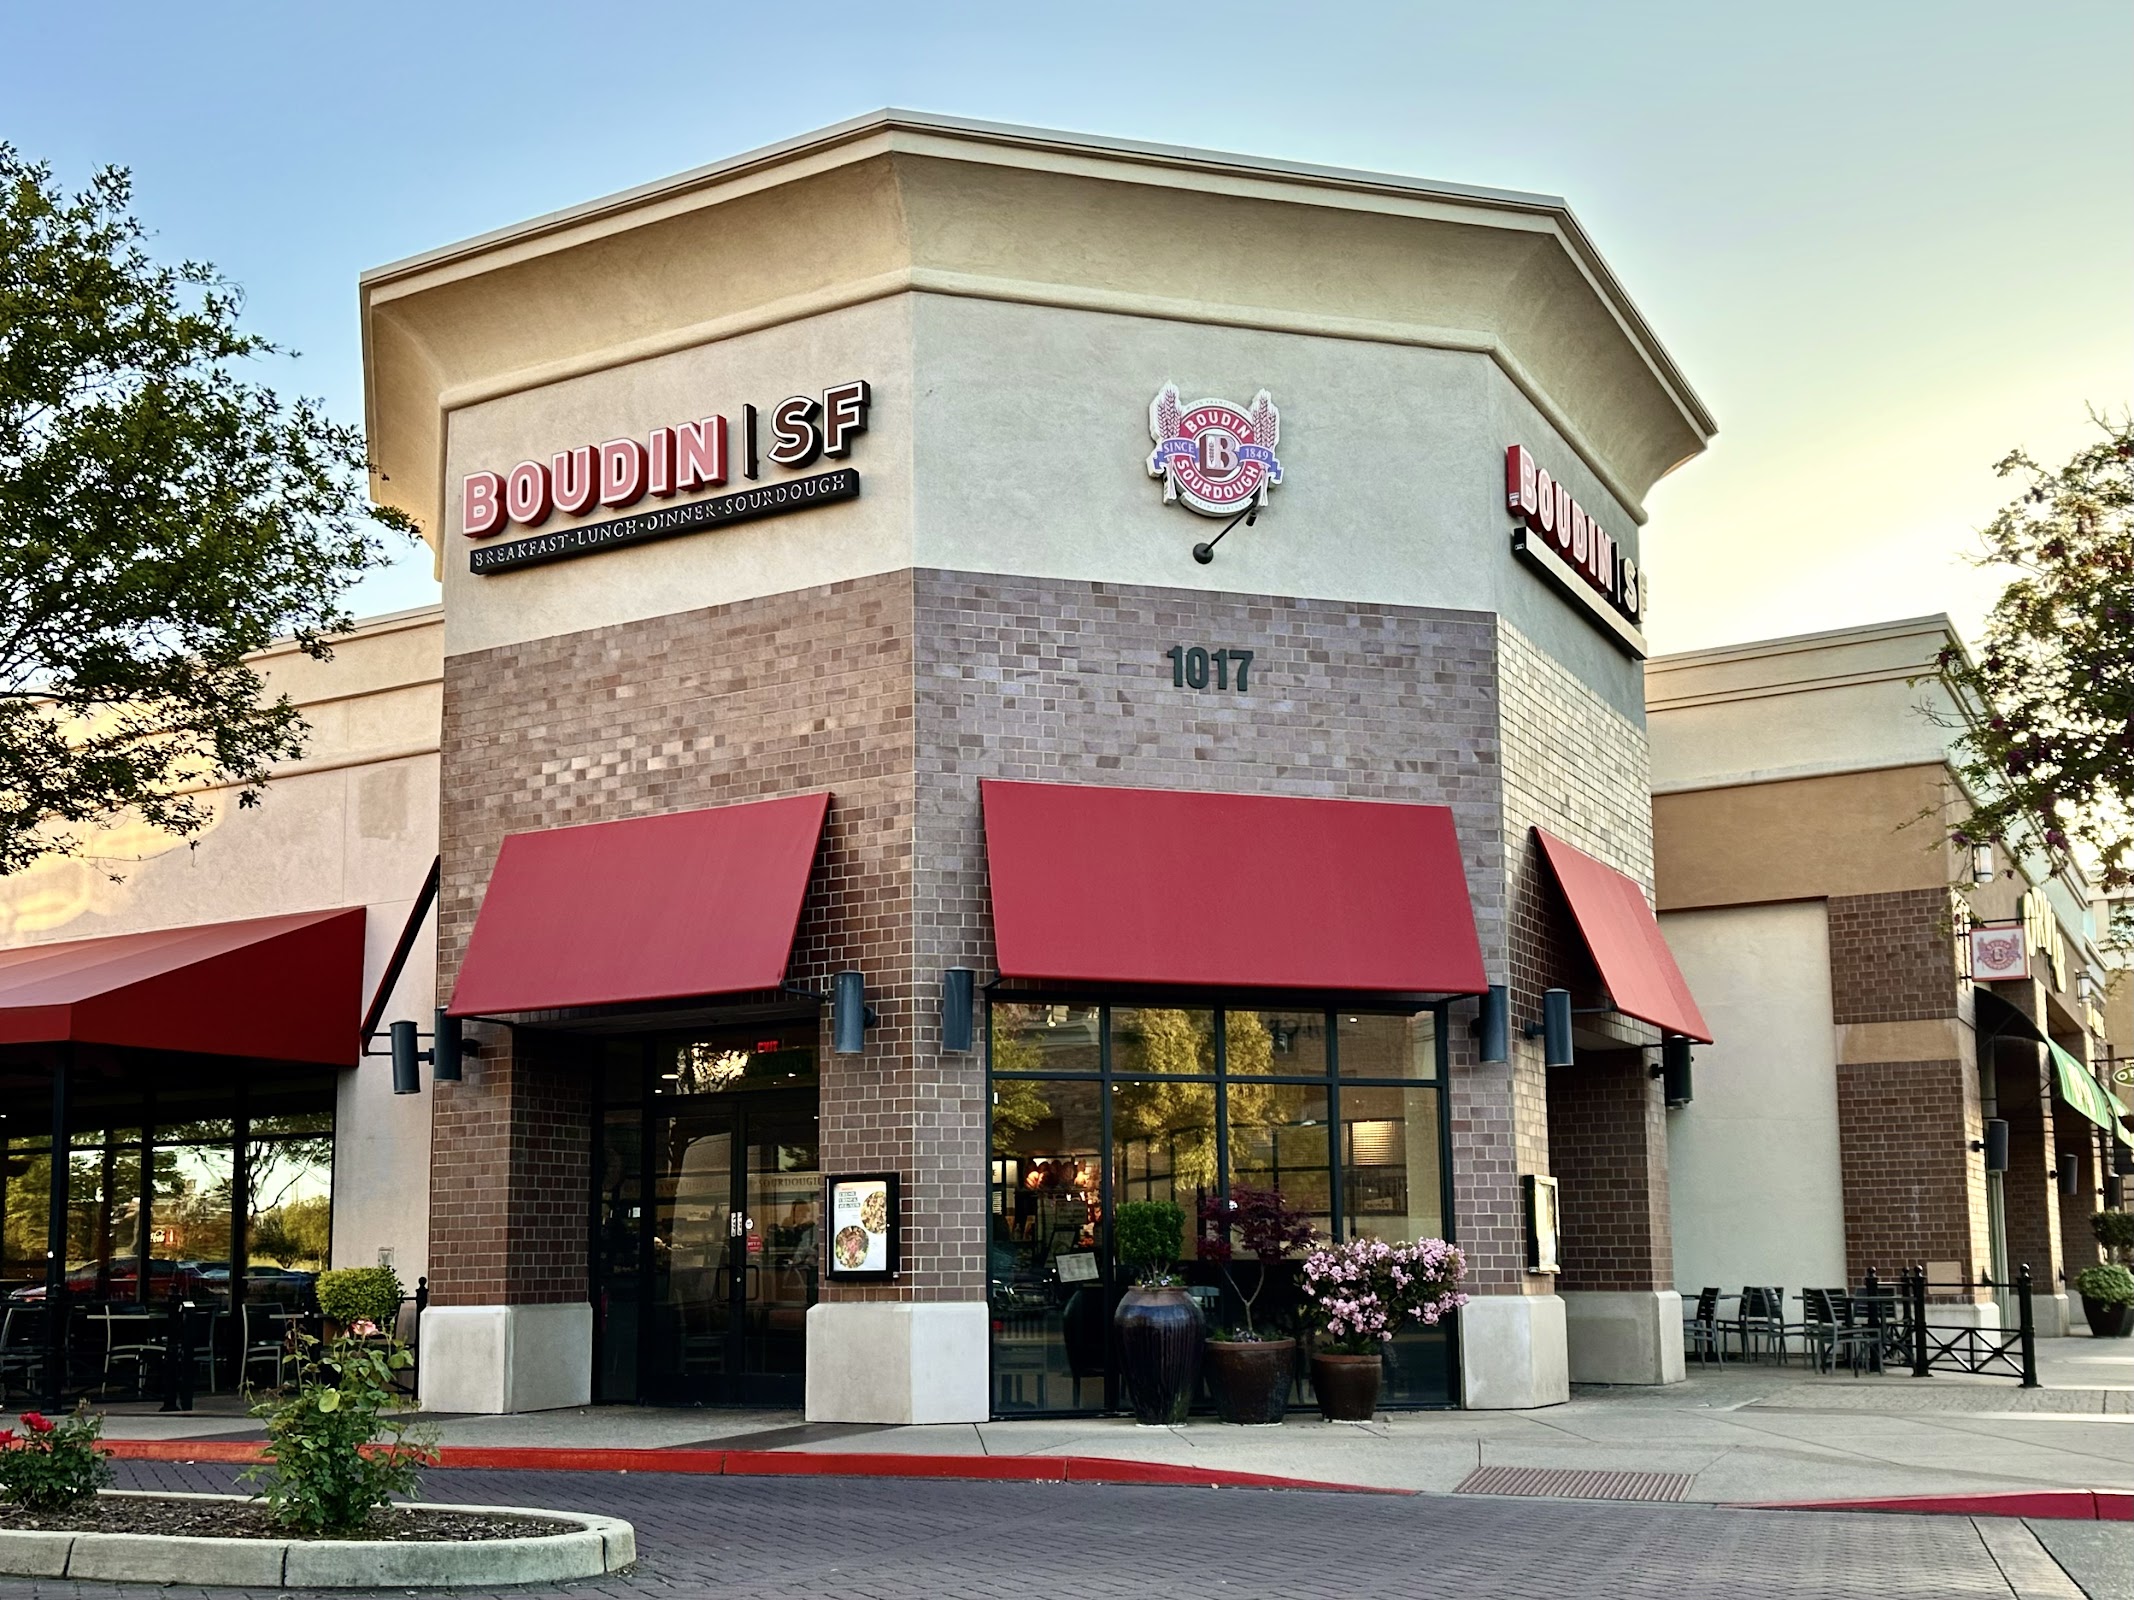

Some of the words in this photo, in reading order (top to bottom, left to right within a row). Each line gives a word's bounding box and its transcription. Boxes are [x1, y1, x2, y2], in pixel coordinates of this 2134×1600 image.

[1184, 411, 1251, 438] BOUDIN
[462, 414, 727, 538] BOUDIN
[767, 379, 871, 468] SF
[1163, 441, 1195, 454] SINCE
[1245, 447, 1269, 461] 1849
[1199, 433, 1239, 478] B
[1176, 459, 1259, 499] SOURDOUGH
[474, 536, 568, 567] BREAKFAST
[576, 520, 637, 546] LUNCH
[646, 505, 716, 531] DINNER
[723, 474, 846, 516] SOURDOUGH
[1518, 444, 1613, 592] BOUDIN
[1624, 557, 1648, 624] SF
[1167, 645, 1254, 692] 1017
[757, 1040, 779, 1053] EXIT
